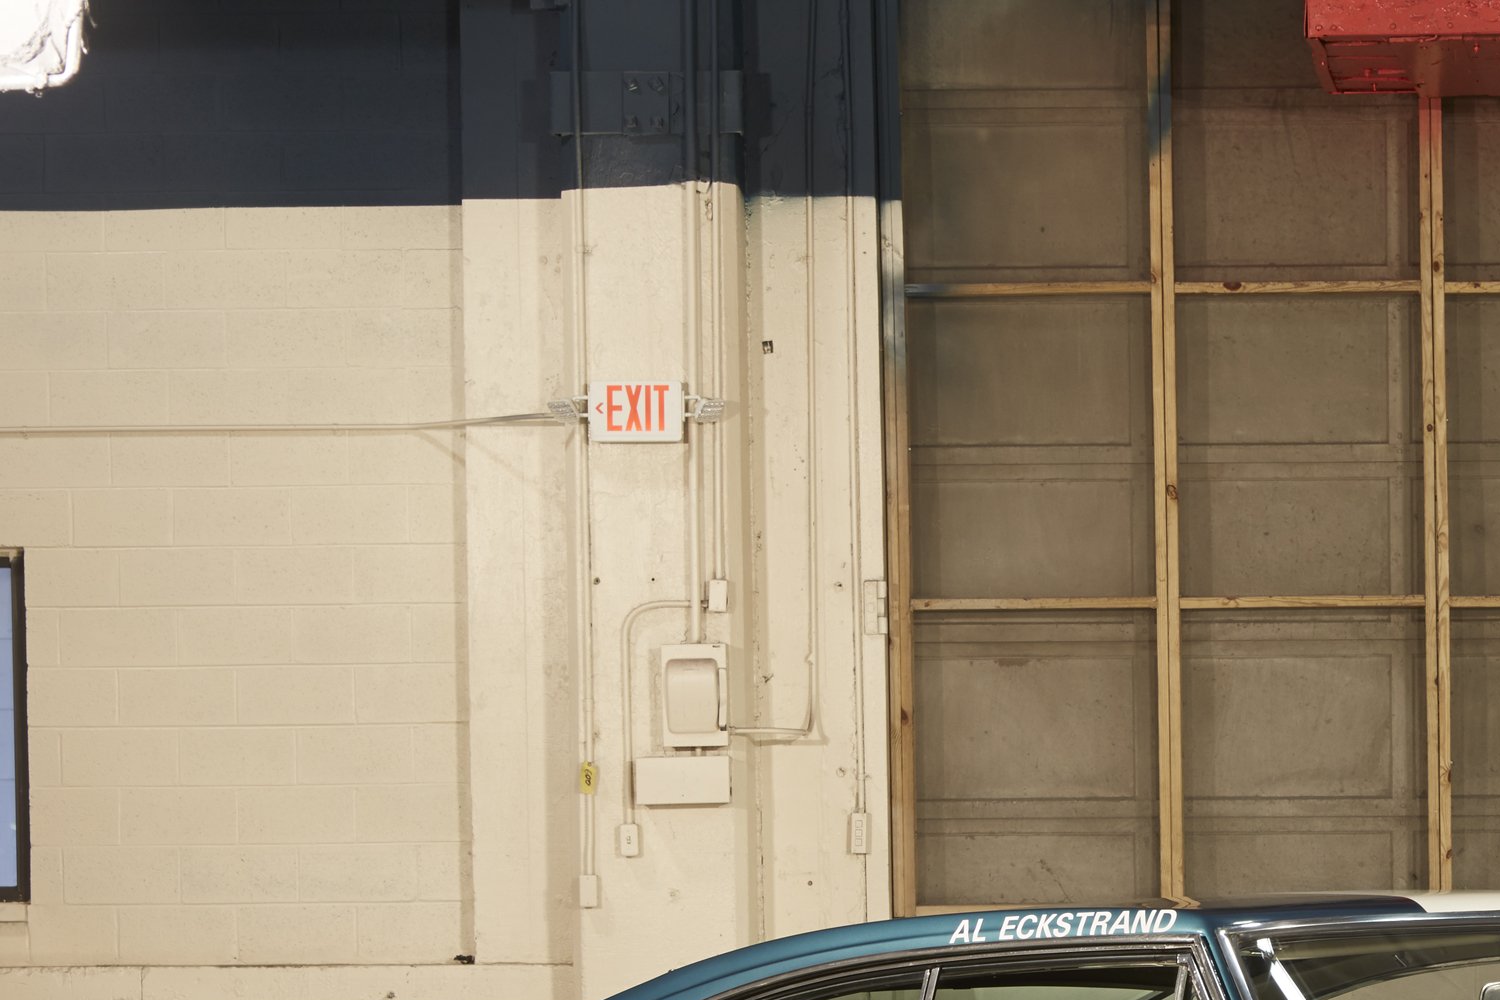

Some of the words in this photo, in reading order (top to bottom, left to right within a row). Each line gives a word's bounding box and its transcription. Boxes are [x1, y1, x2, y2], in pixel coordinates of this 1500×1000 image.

[606, 384, 670, 432] EXIT
[949, 918, 987, 944] AL
[998, 909, 1177, 941] ECKSTRAND
